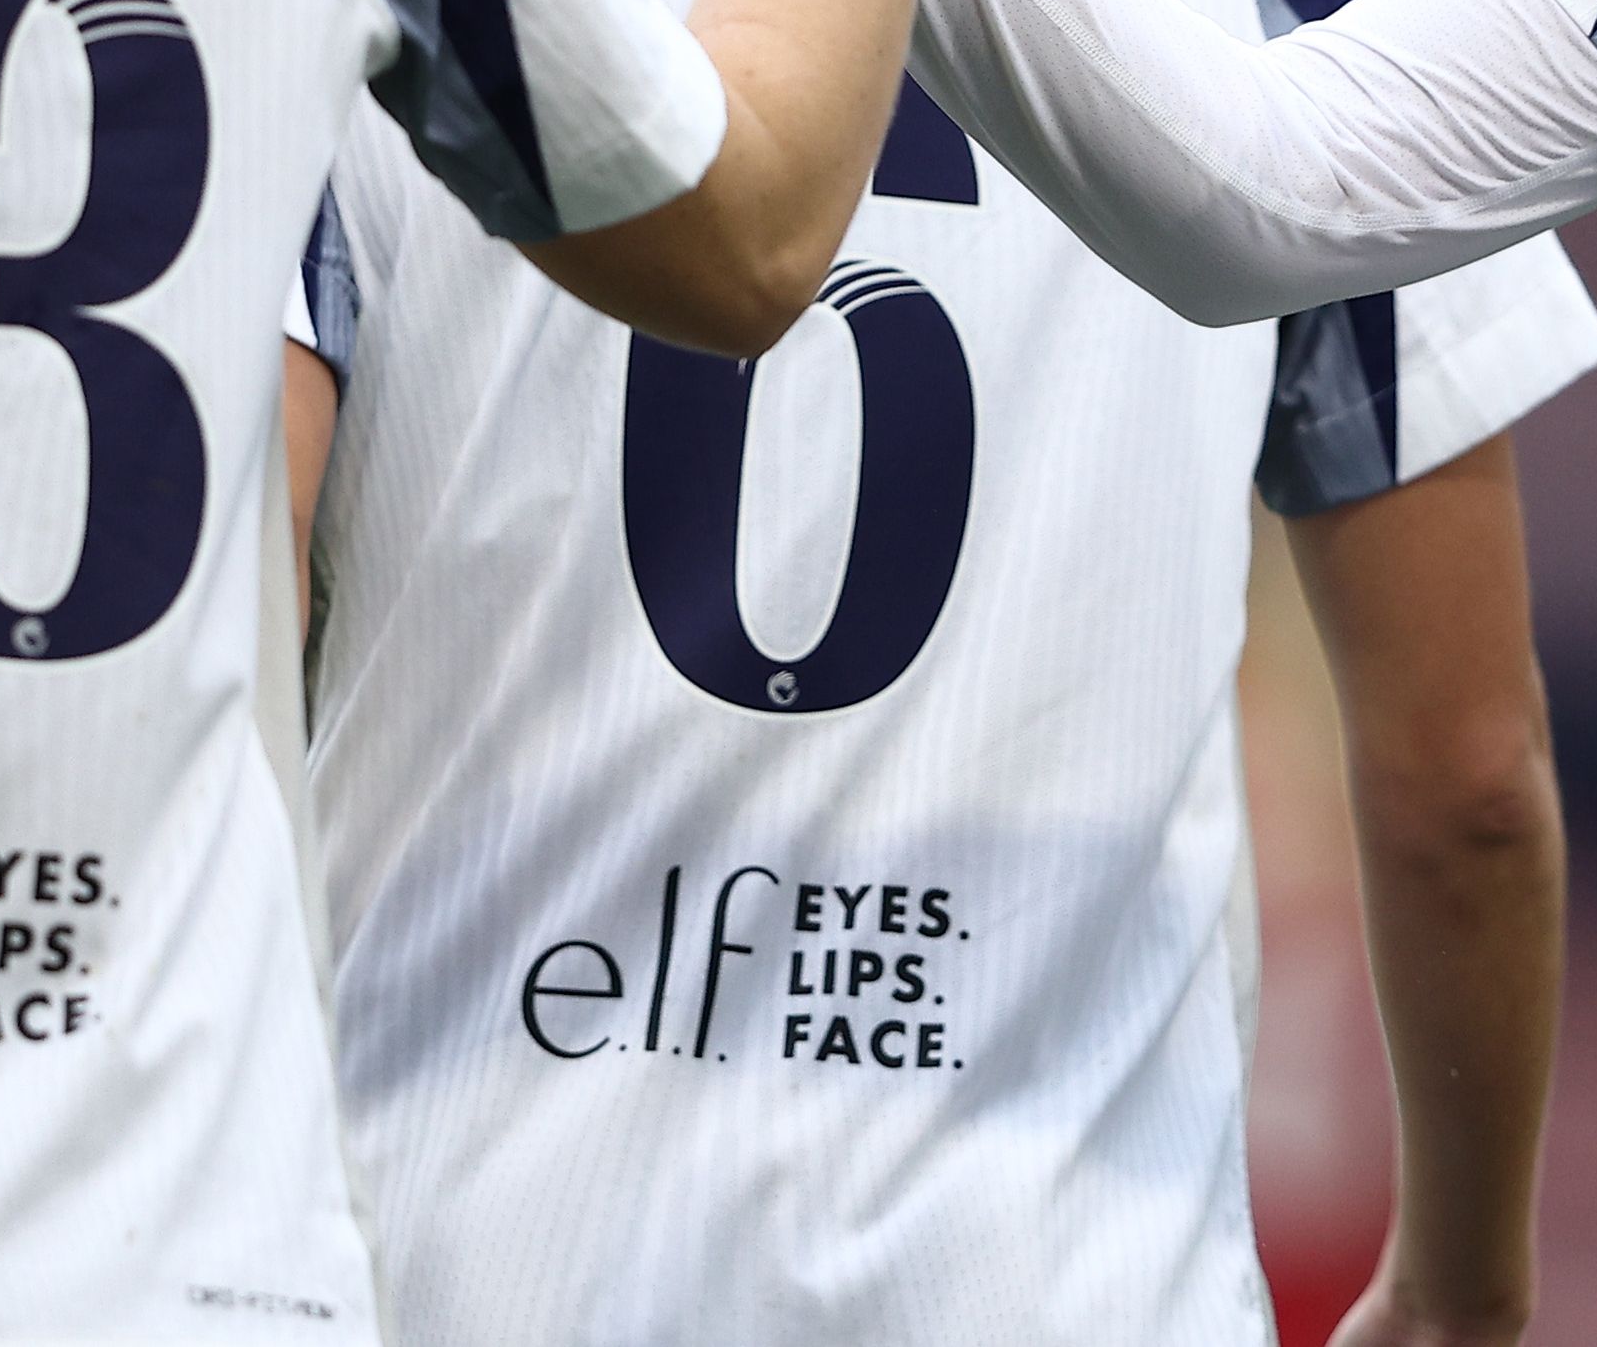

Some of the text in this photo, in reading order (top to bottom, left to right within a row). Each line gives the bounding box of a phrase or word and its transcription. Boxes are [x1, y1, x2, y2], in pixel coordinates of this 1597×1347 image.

[794, 883, 970, 941] EYES.
[787, 949, 945, 1005] LIPS.
[783, 1013, 964, 1070] FACE.
